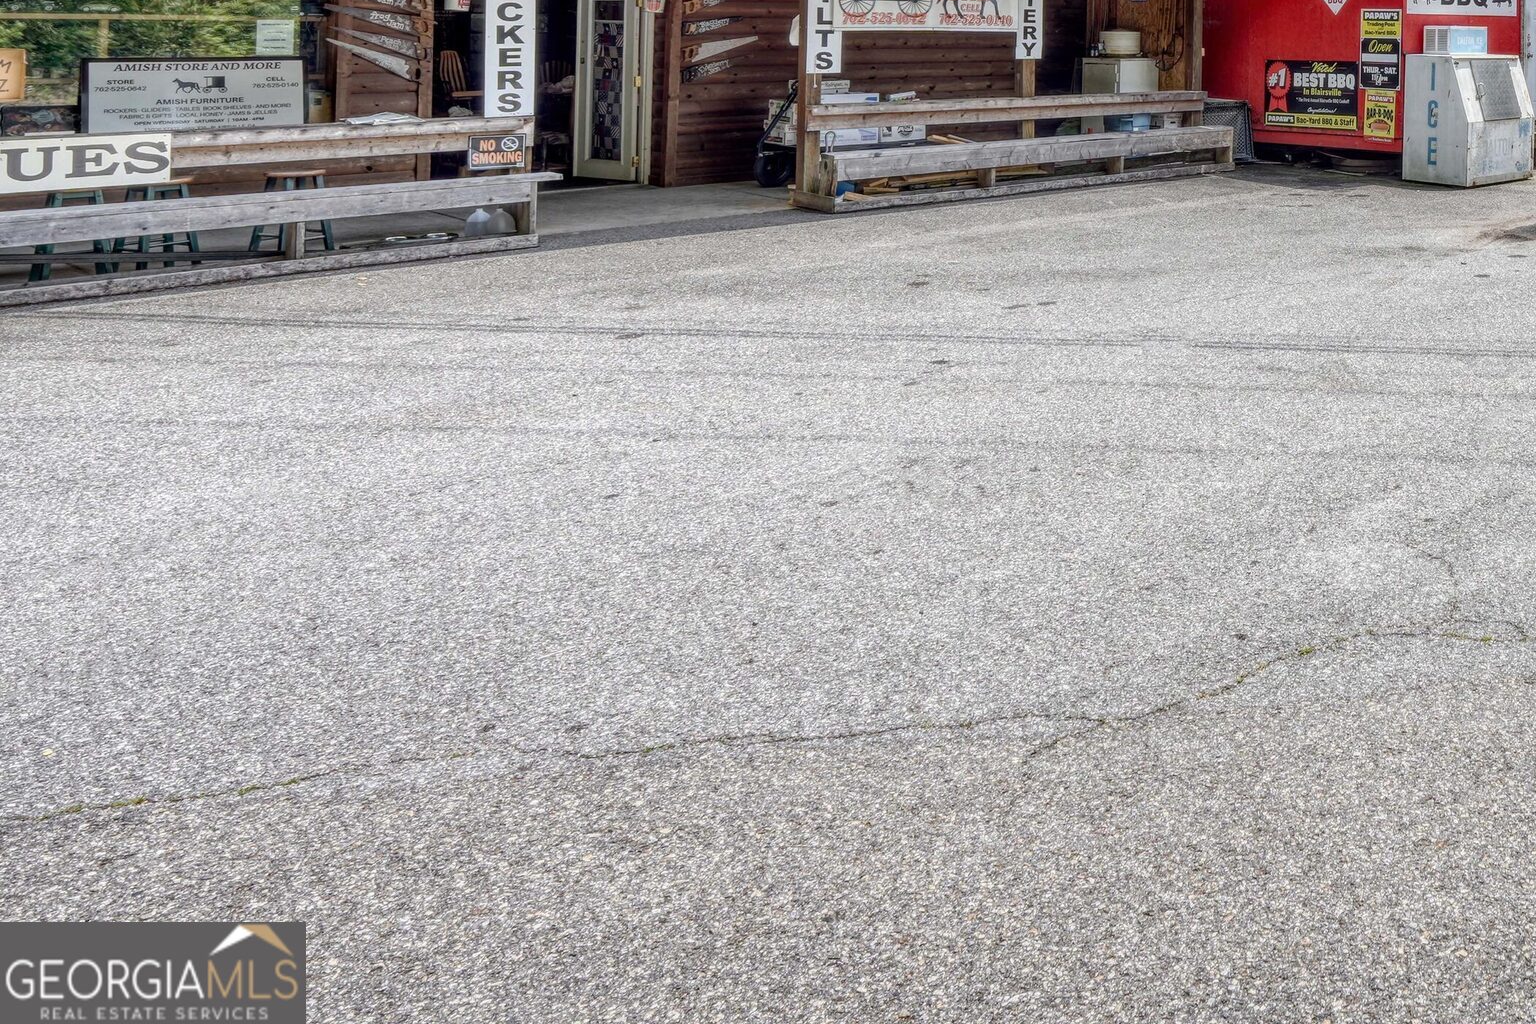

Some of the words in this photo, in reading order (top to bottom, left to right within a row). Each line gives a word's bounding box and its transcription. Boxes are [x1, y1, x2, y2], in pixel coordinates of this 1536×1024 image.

[1364, 12, 1398, 20] PAPAW'S
[1368, 39, 1393, 53] Open
[114, 63, 162, 72] AMISH
[164, 62, 208, 72] STORE
[210, 62, 240, 71] AND
[242, 61, 281, 70] MORE
[1311, 62, 1337, 73] Voted
[1268, 67, 1286, 87] #1
[1293, 73, 1326, 88] BEST
[1327, 73, 1356, 90] BBQ
[1303, 87, 1310, 95] In
[1311, 88, 1342, 96] Blairsville
[1368, 95, 1393, 103] PAPAW'S
[1427, 62, 1439, 166] ICE
[1267, 115, 1294, 123] PAPAW'S
[1296, 116, 1320, 125] Bac-Yard
[1322, 117, 1332, 126] BBQ
[1334, 118, 1339, 126] &
[1340, 118, 1355, 127] Staff
[480, 139, 496, 151] NO
[0, 141, 171, 182] UES
[472, 151, 522, 165] SMOKING
